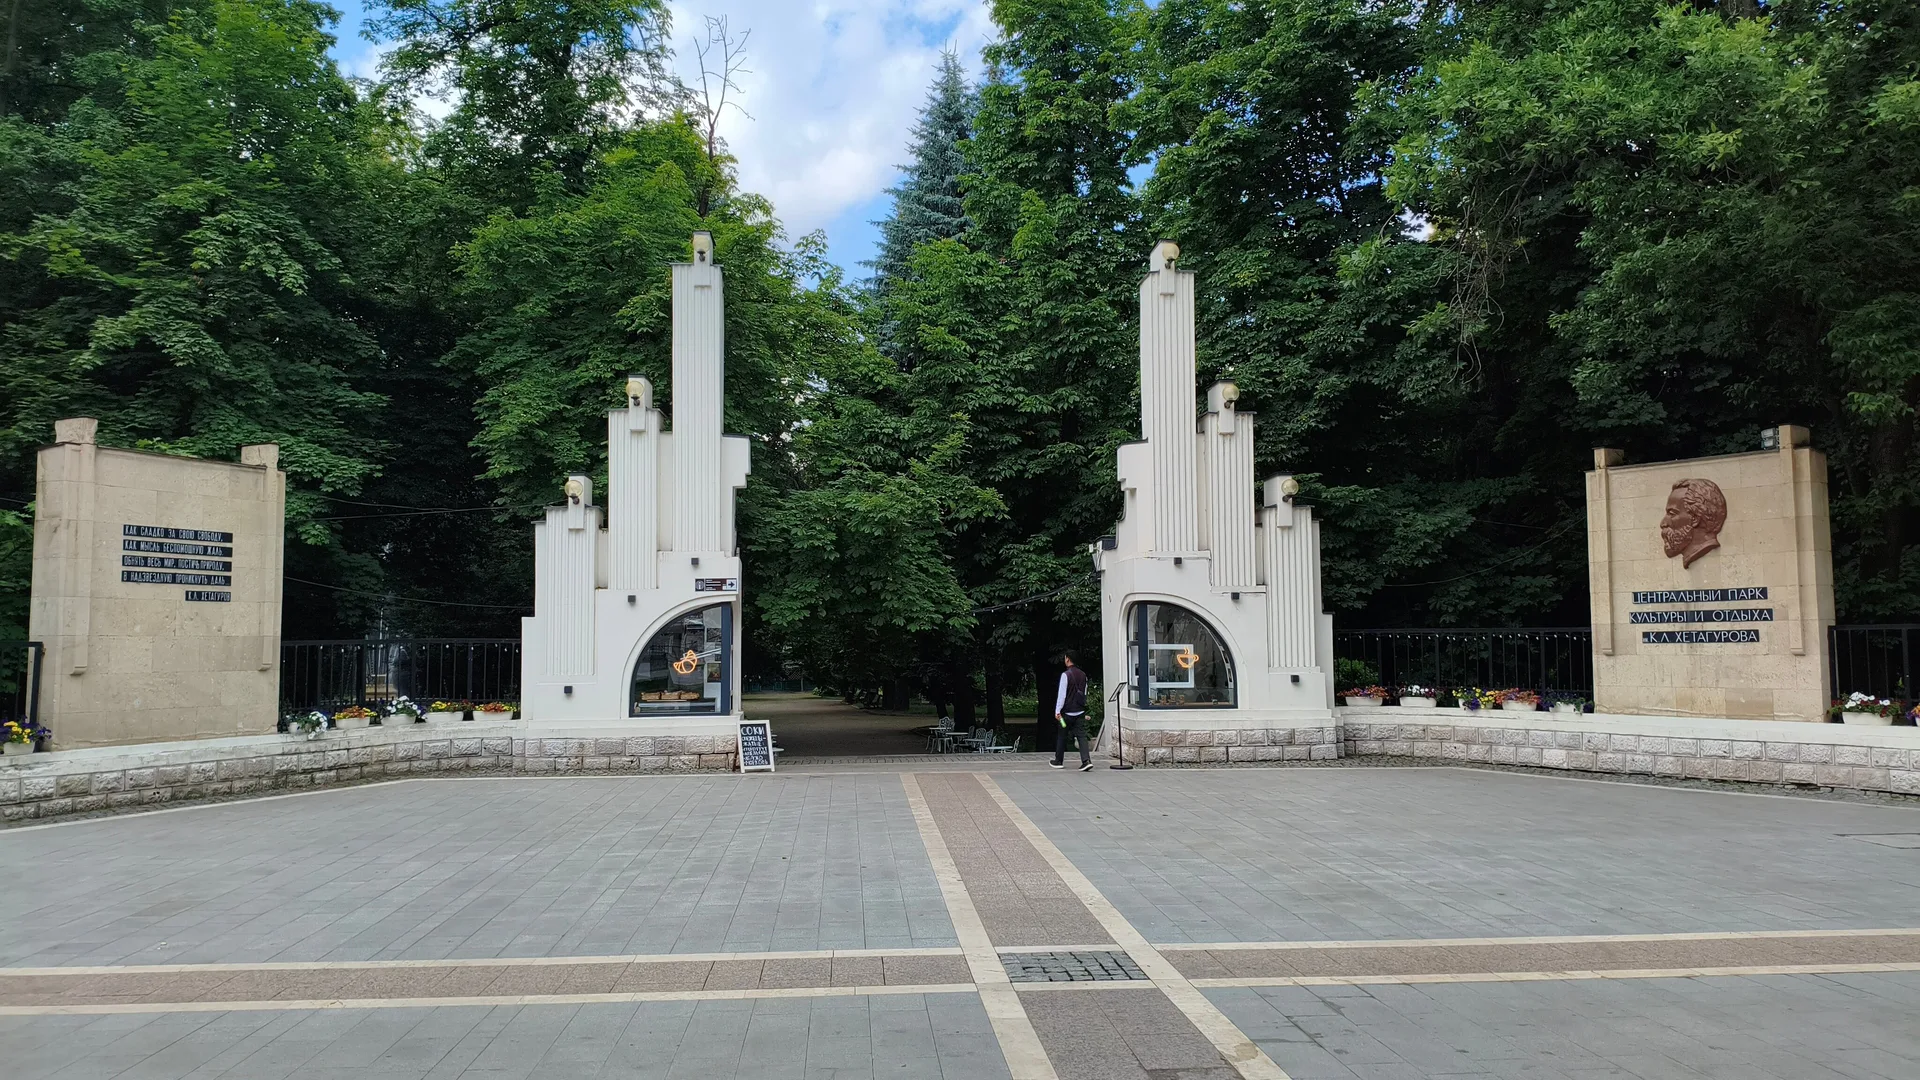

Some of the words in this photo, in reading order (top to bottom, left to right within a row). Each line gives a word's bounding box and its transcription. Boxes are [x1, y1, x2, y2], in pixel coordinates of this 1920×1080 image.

[125, 525, 137, 535] КАК
[140, 526, 165, 538] СЛАДКО
[168, 529, 176, 538] ЗА
[179, 529, 195, 540] СВОЮ
[125, 539, 137, 550] КАК
[140, 540, 160, 551] МЫСЛЬ
[124, 555, 145, 566] ОБНЯТЬ
[147, 557, 162, 567] ВЕСЬ
[123, 571, 128, 581] В
[130, 571, 173, 583] НАДЗВЕЗДНУЮ
[175, 573, 208, 585] ПРОНИКНУТЬ
[201, 591, 231, 601] ХЕТАГУРОВ
[1728, 587, 1765, 600] ПАРК
[1629, 611, 1687, 623] КУЛЬТУРЫ
[1694, 610, 1704, 622] И
[1712, 609, 1771, 622] ОТДЫХА
[1675, 630, 1758, 643] ХЕТАГУРОВА
[741, 726, 765, 735] СОКИ
